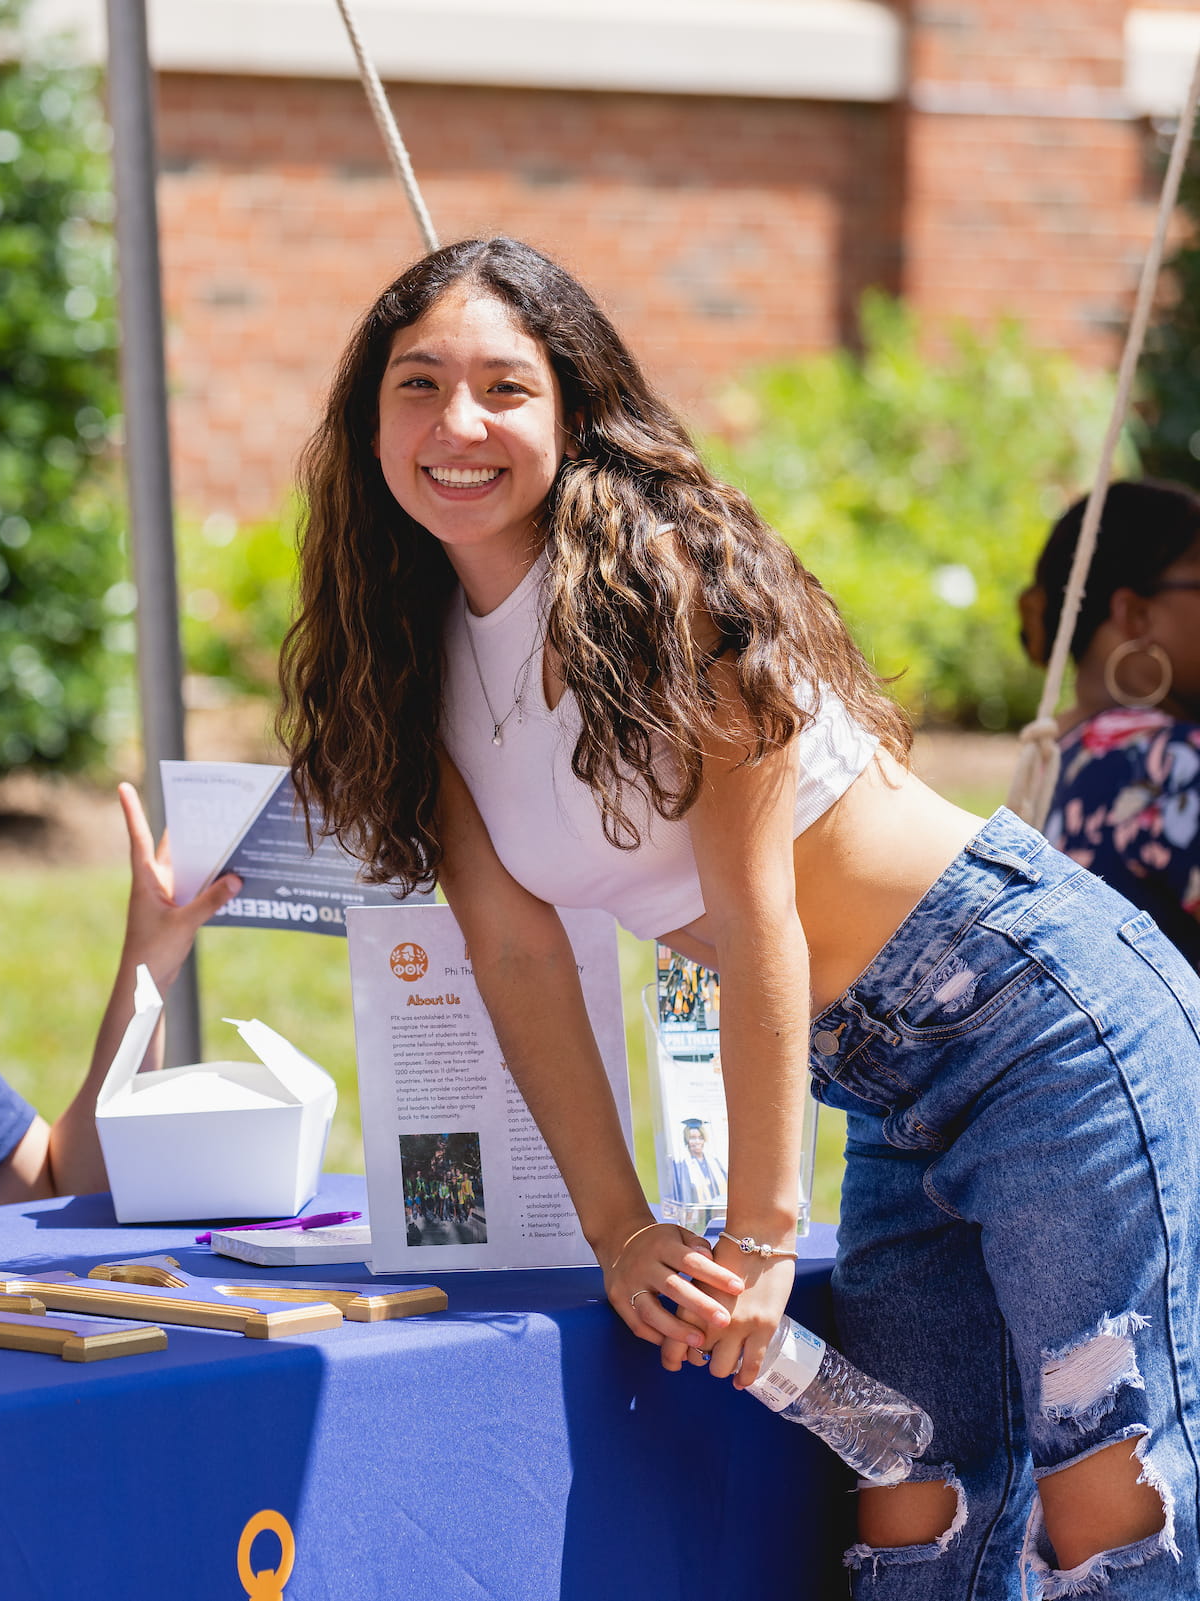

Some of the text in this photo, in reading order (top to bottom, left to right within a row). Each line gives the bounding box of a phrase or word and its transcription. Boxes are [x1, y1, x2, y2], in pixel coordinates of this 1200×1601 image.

[319, 906, 344, 924] TO
[445, 967, 458, 976] Phi
[406, 993, 461, 1007] About Us
